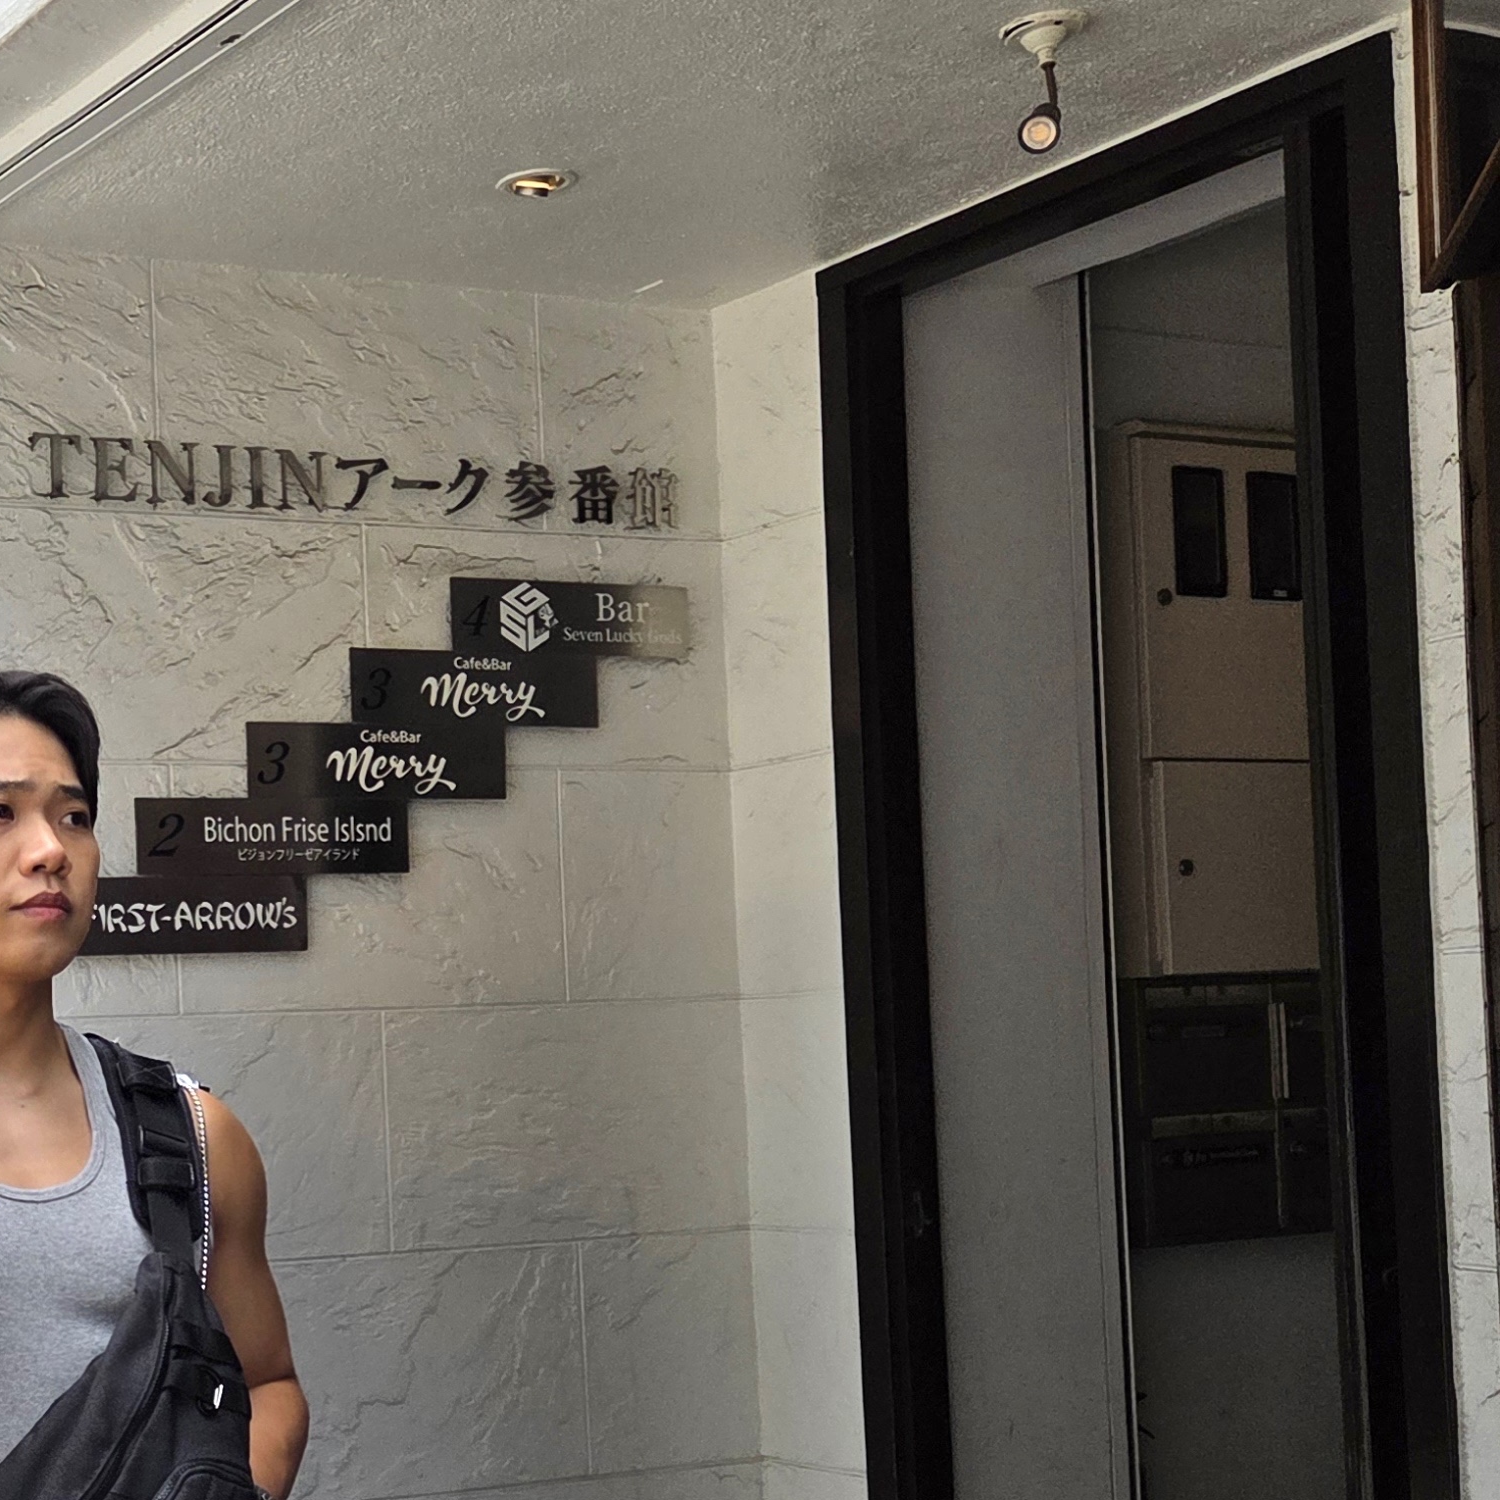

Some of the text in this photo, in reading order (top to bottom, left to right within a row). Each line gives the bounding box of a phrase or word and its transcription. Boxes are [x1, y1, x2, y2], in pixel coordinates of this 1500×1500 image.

[463, 594, 491, 637] 4
[595, 592, 650, 623] Bar
[563, 627, 604, 643] Seven
[606, 628, 644, 647] Lucky
[453, 656, 512, 671] Cafe&Bar
[361, 667, 392, 711] 3
[420, 672, 546, 722] Merry
[360, 729, 422, 744] Cafe&Bar
[257, 741, 291, 785] 3
[326, 746, 457, 795] Merry
[146, 813, 186, 858] 2
[203, 815, 392, 844] Bichon Frise Islsnd
[91, 897, 298, 933] IRST-ARROW's
